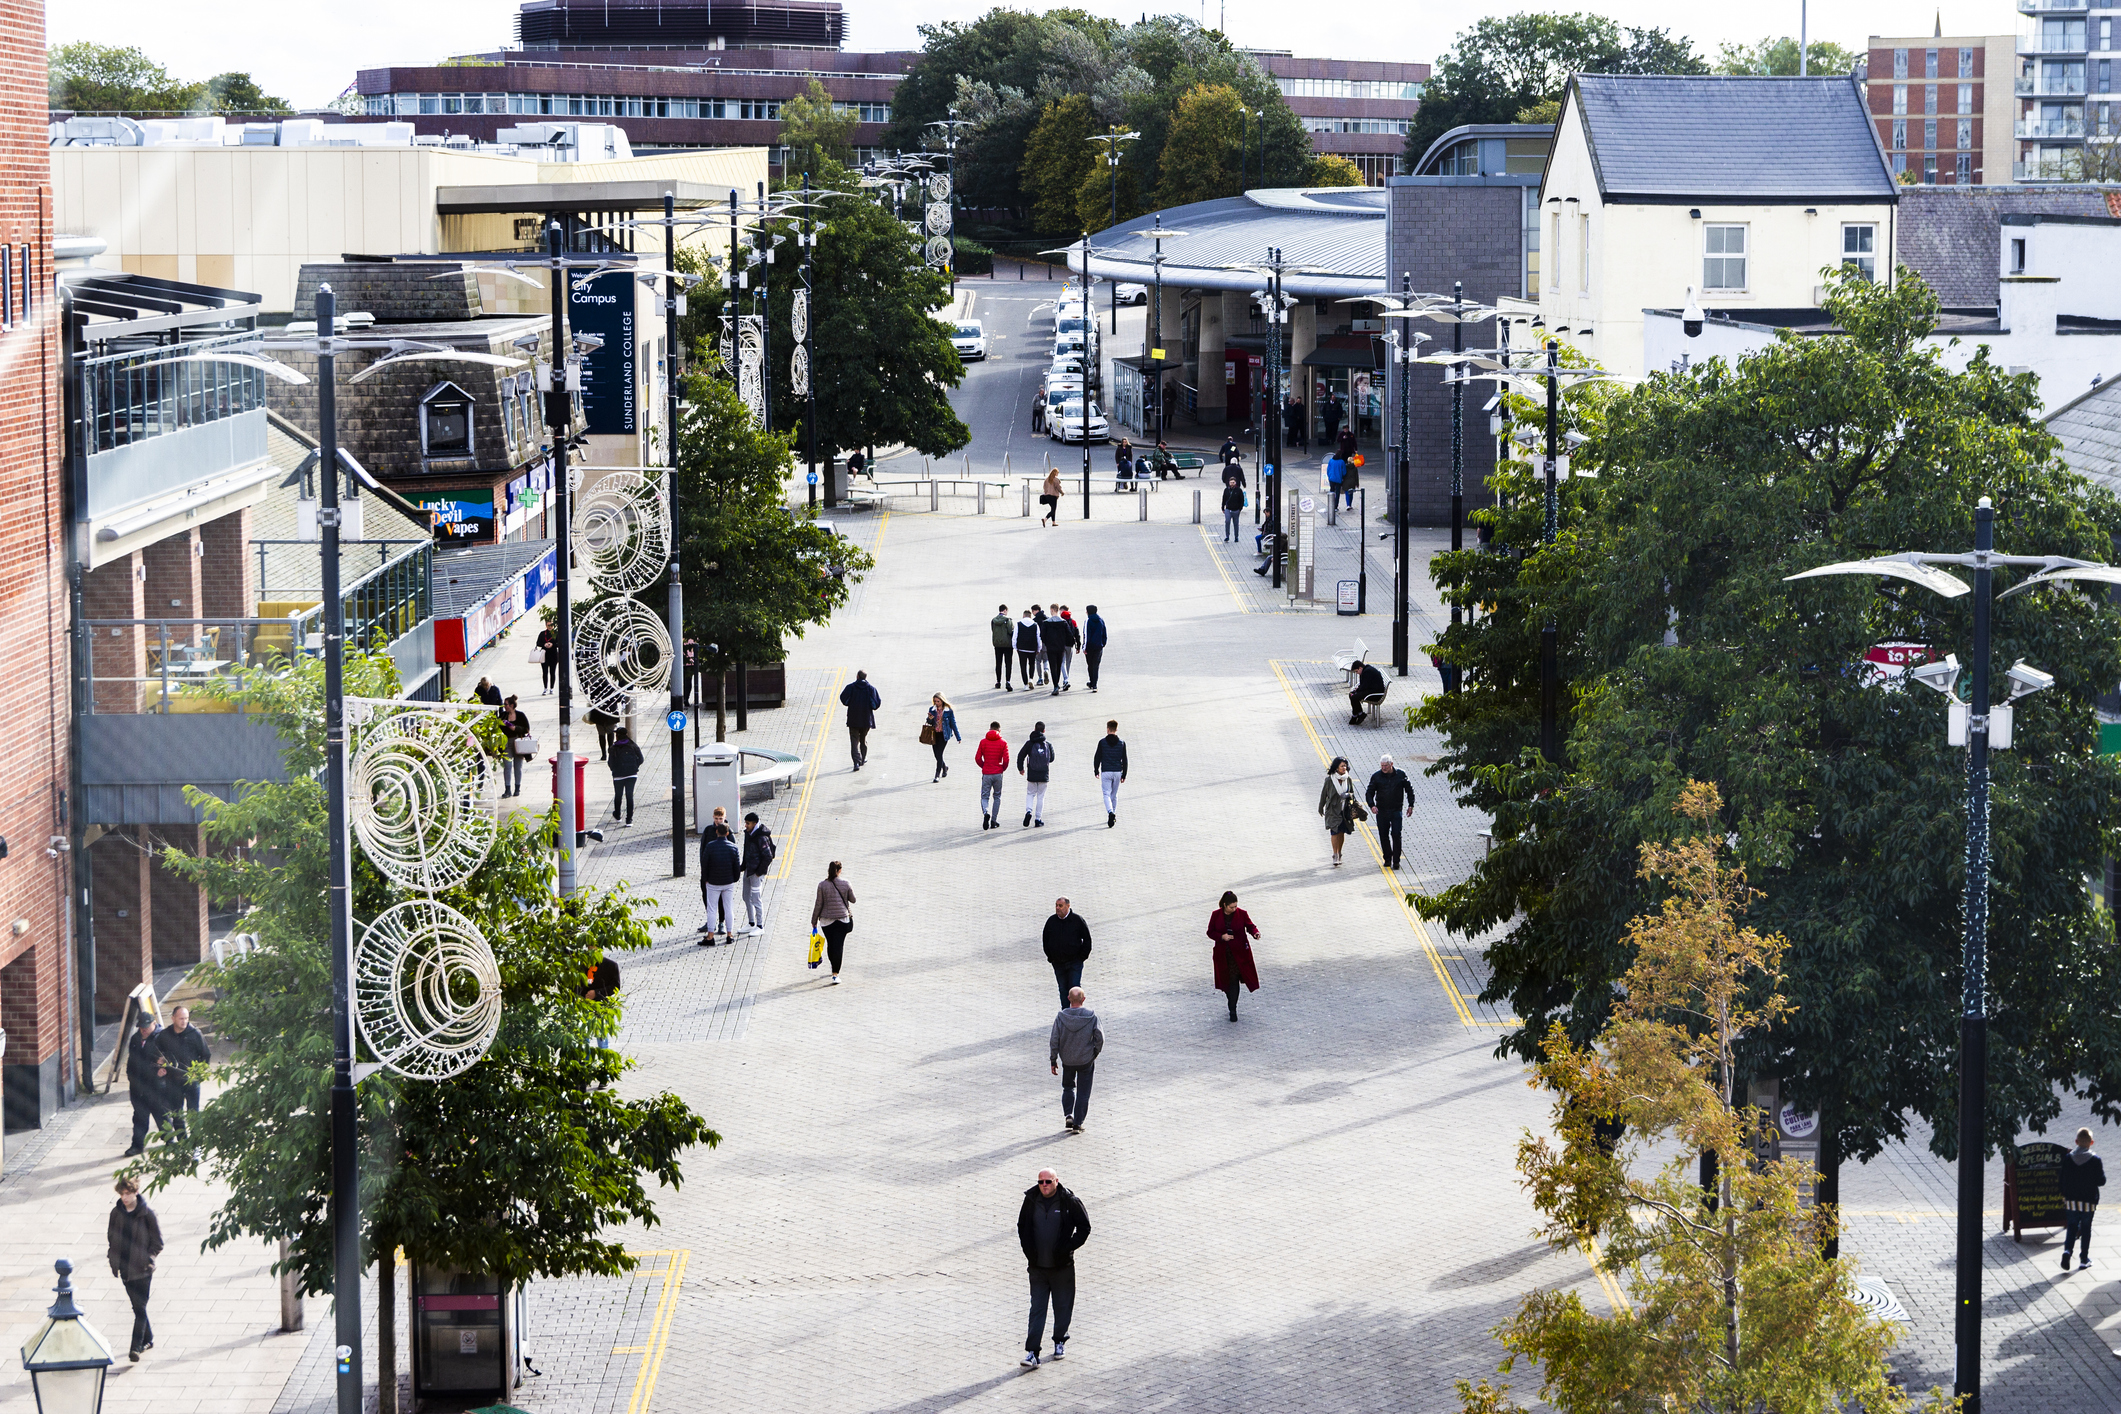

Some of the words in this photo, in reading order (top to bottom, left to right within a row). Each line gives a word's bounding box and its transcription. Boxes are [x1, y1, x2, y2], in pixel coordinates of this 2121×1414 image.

[571, 292, 617, 306] Campus
[623, 311, 632, 358] COLLEGE
[624, 361, 633, 430] SUNDERLAND
[419, 498, 457, 511] Lucky
[432, 509, 463, 525] Devil
[445, 522, 479, 537] Vapes
[1887, 650, 1905, 662] to
[1908, 649, 1926, 662] le
[2020, 1144, 2053, 1155] WEEKLY
[2019, 1153, 2061, 1165] SPECIALS
